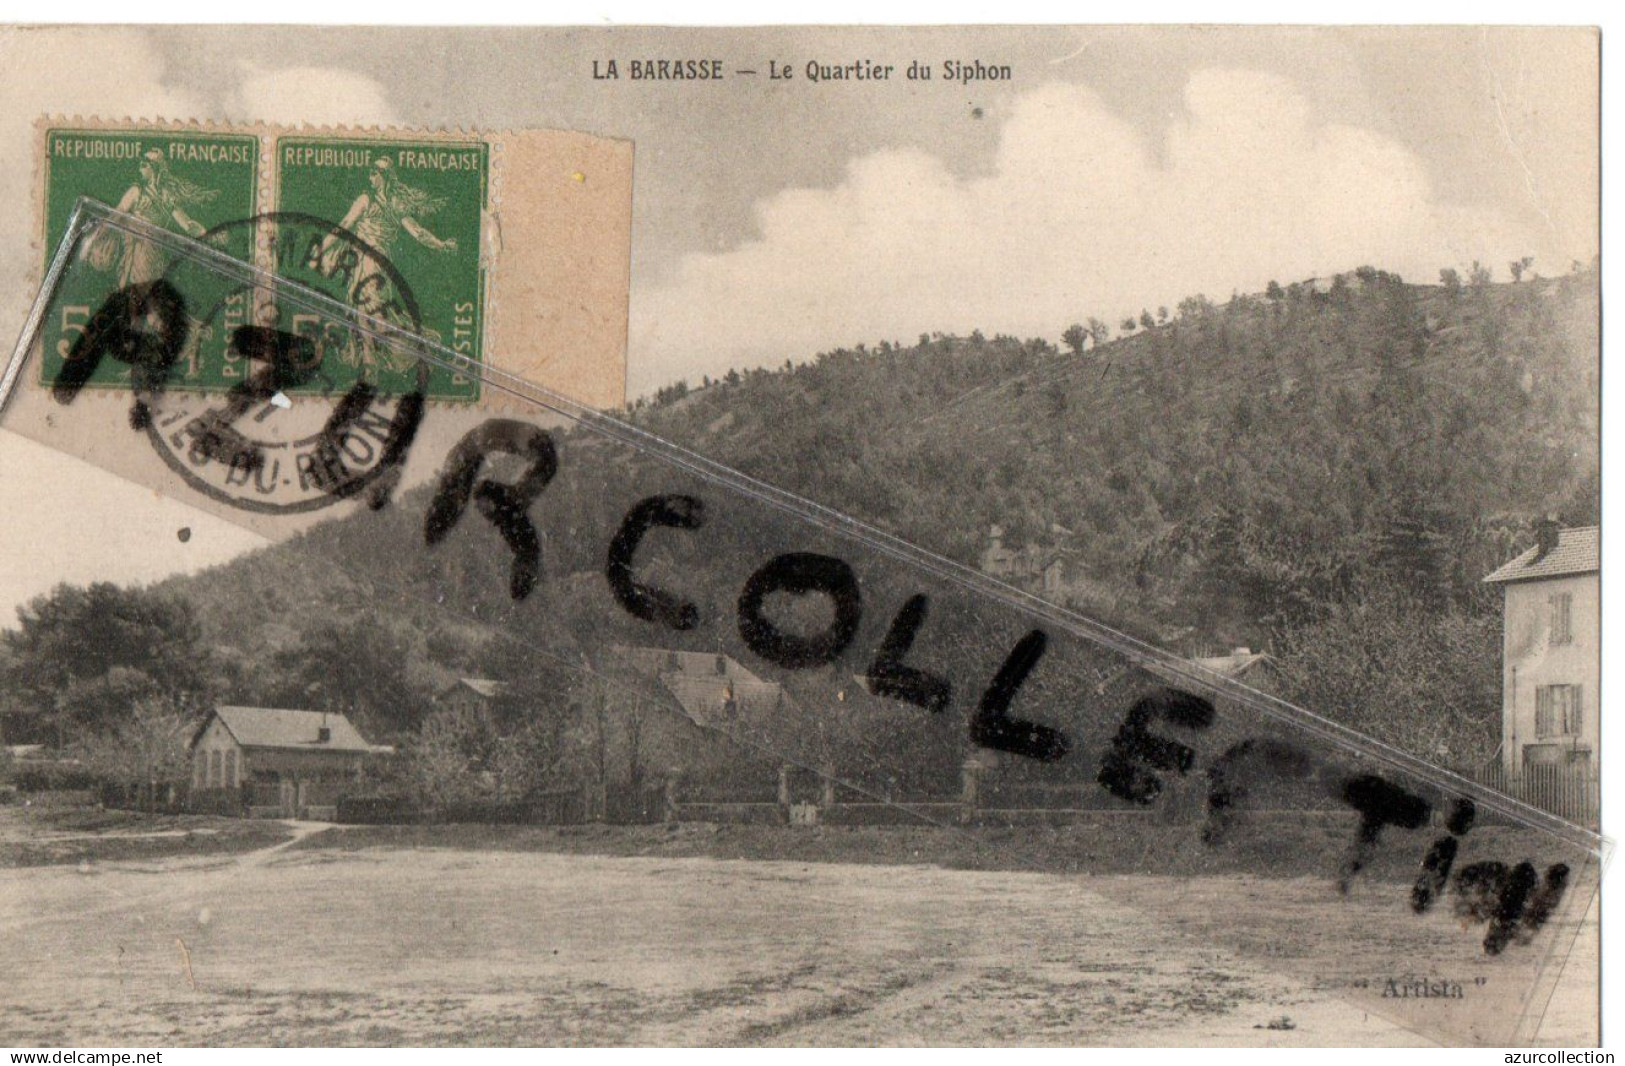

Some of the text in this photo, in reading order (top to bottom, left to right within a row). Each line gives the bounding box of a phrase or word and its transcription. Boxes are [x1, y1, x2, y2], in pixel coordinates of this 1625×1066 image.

[592, 60, 619, 80] LA
[630, 60, 724, 80] BARASSE
[769, 60, 794, 80] Le
[805, 60, 894, 82] Quartier
[906, 60, 932, 80] du
[942, 60, 1012, 85] Siphon
[169, 142, 250, 164] FRANÇAISE
[398, 150, 479, 172] FRANÇAISE
